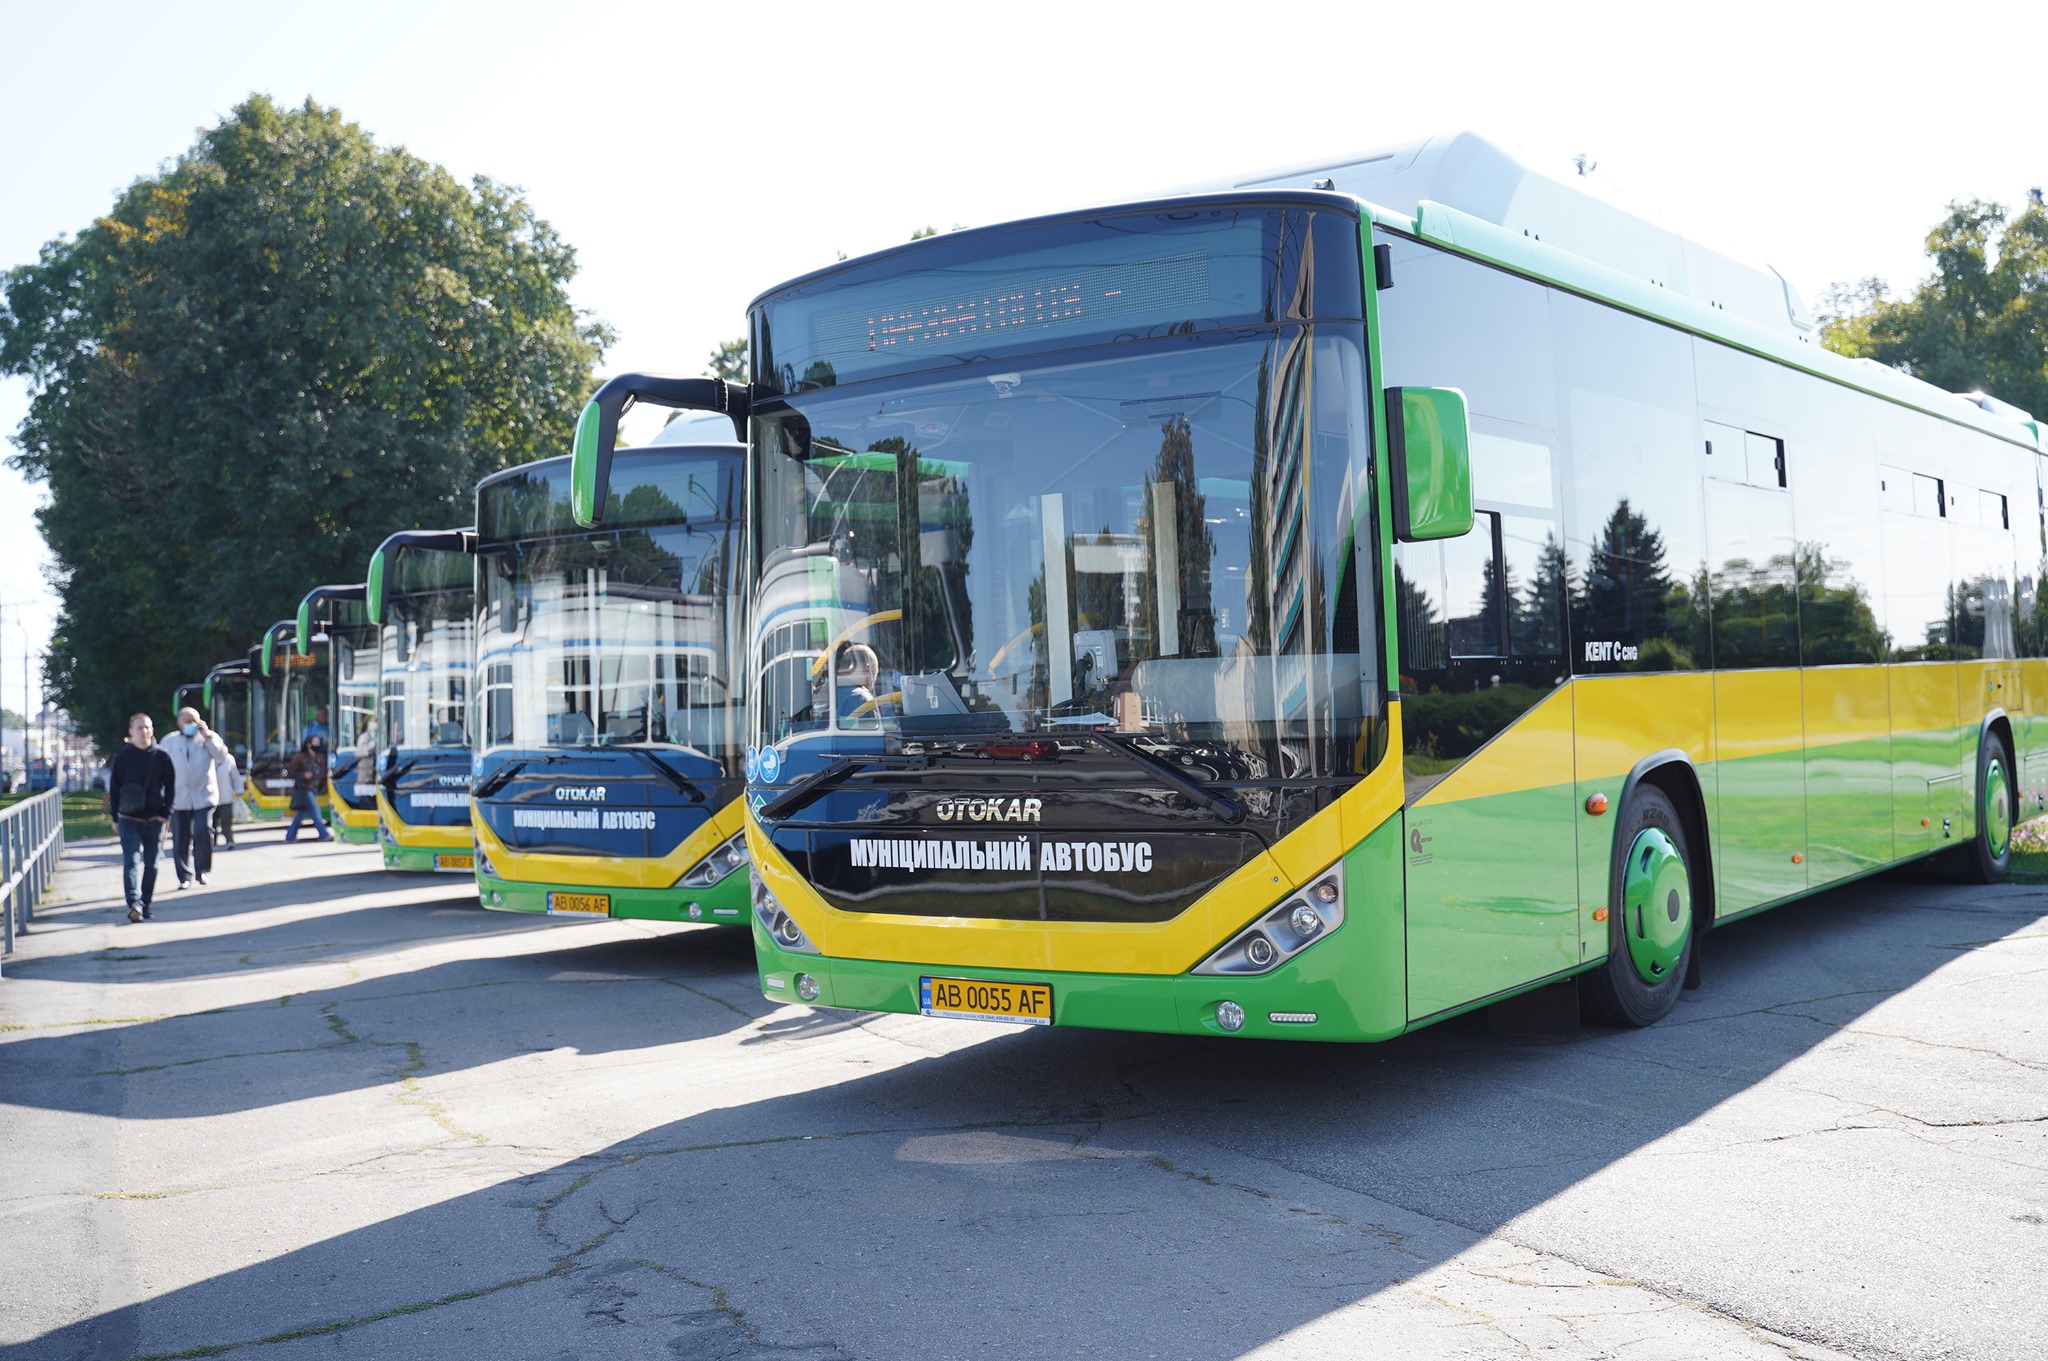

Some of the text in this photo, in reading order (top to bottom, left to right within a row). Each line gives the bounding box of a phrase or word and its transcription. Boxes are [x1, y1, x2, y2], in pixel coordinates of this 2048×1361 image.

[1585, 641, 1638, 661] KENT C CNG
[555, 786, 606, 801] OTOKAR
[513, 808, 656, 830] МУНІЦИПАЛЬНИЙ АВТОБУС
[936, 798, 1042, 822] OTOKAR
[850, 835, 1153, 873] МУНІЦИПАЛЬНИЙ АВТОБУС
[554, 896, 607, 912] AB 0056 AF
[922, 997, 931, 1005] UA
[936, 984, 1046, 1014] AB 0055 AF
